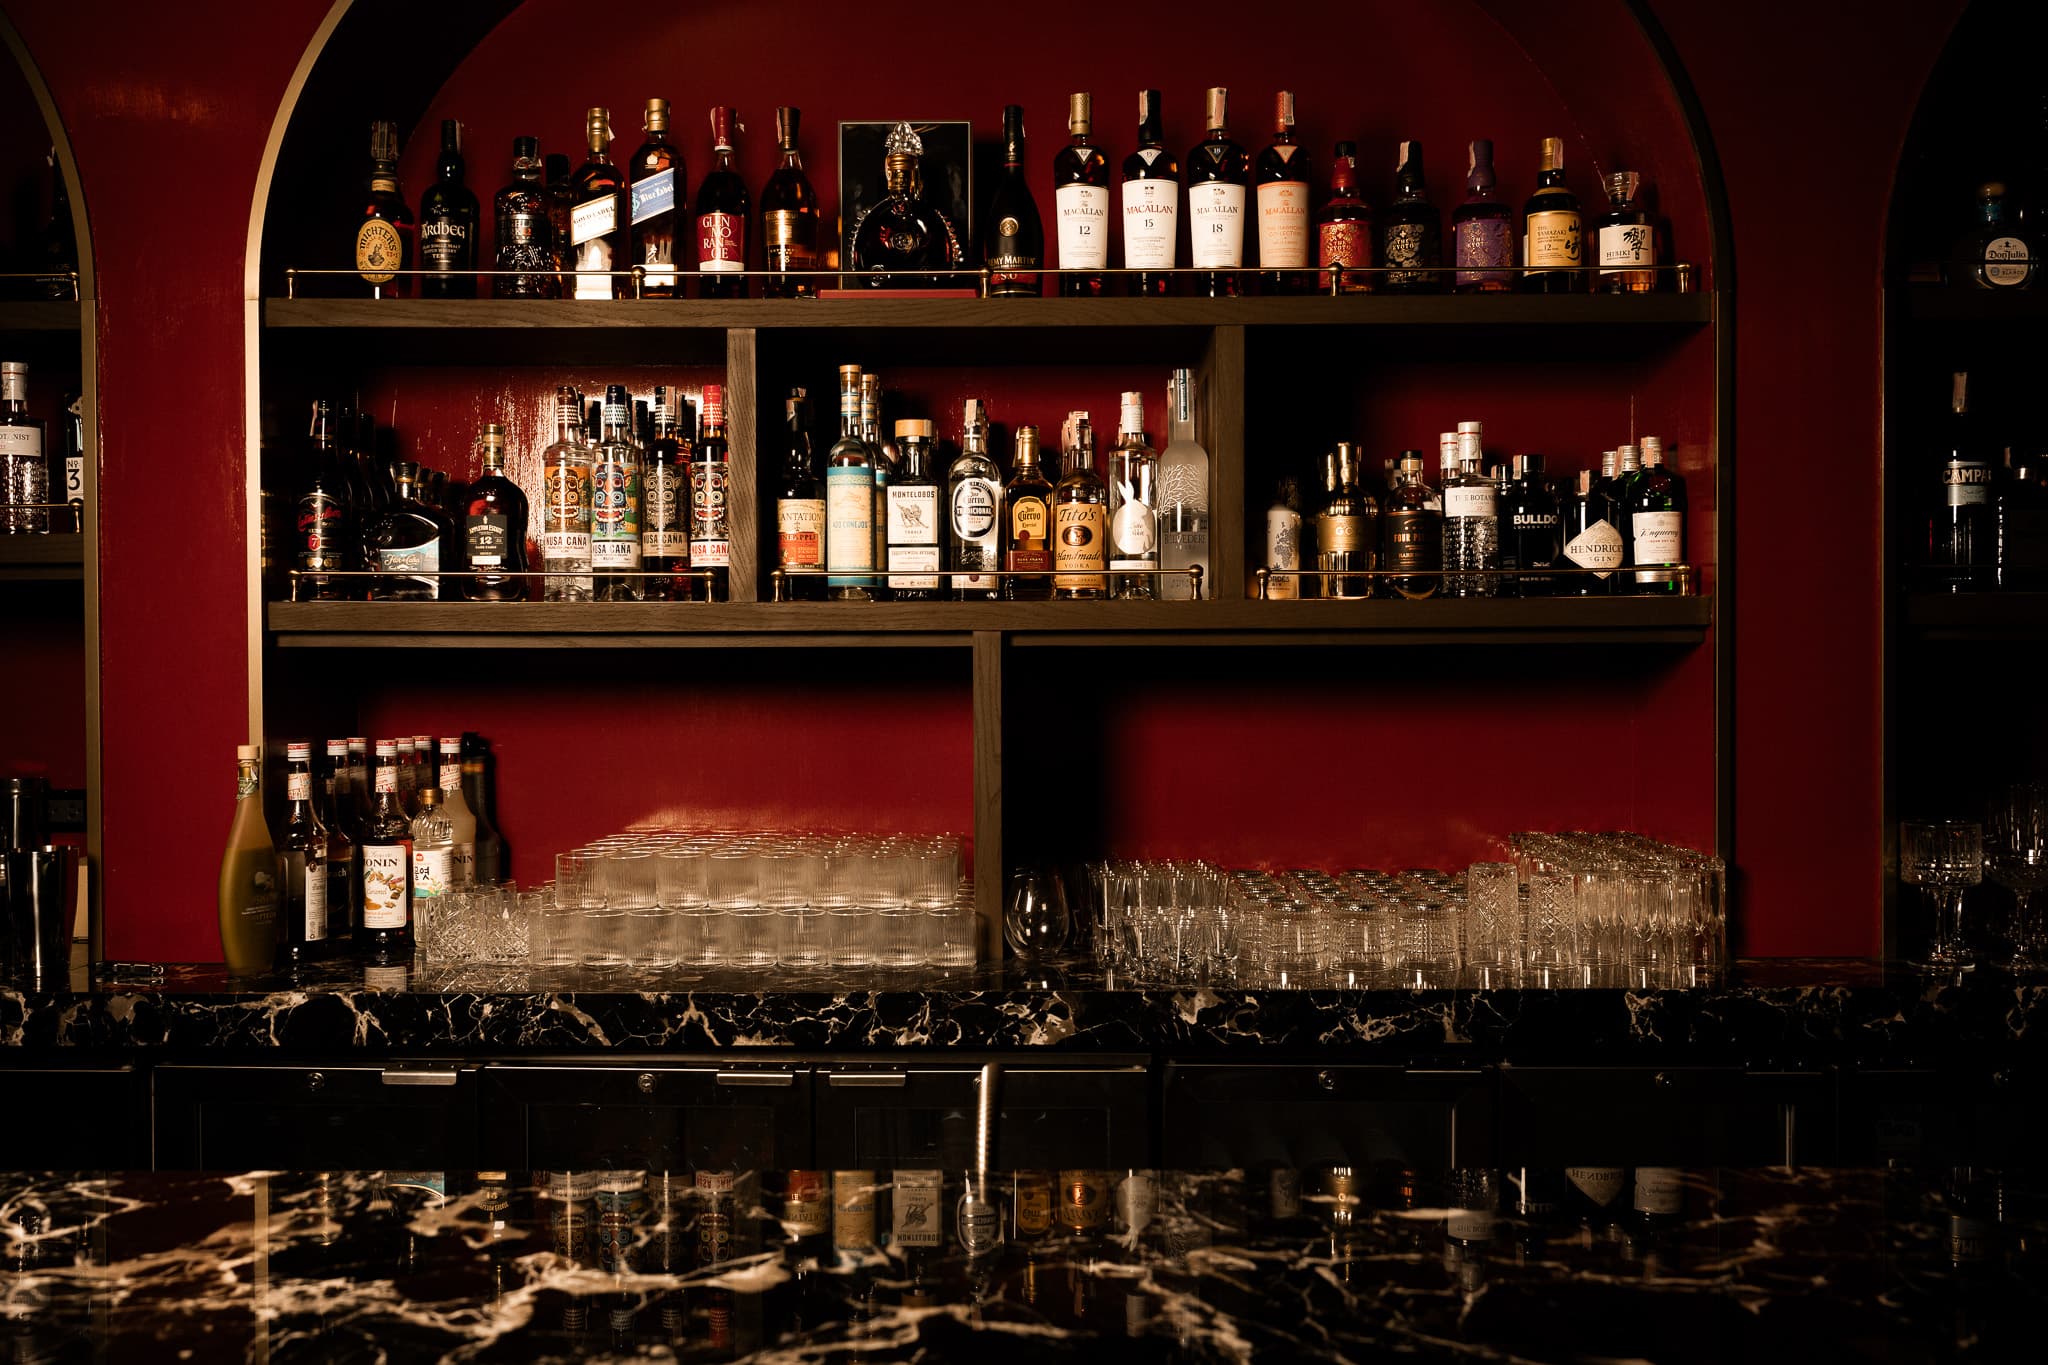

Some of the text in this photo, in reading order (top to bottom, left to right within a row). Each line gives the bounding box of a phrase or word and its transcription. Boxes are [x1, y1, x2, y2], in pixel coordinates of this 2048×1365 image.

[1063, 207, 1105, 217] MACALLAN
[1126, 204, 1173, 215] MACALLAN
[1144, 219, 1154, 228] 15
[1212, 223, 1224, 233] 18
[1079, 225, 1091, 235] 12
[68, 469, 81, 490] 3
[892, 490, 936, 499] MONTELOBOS
[1017, 510, 1042, 522] Cuervo
[1059, 508, 1097, 522] Tito's
[479, 536, 494, 545] 12
[566, 533, 588, 547] CAÑA
